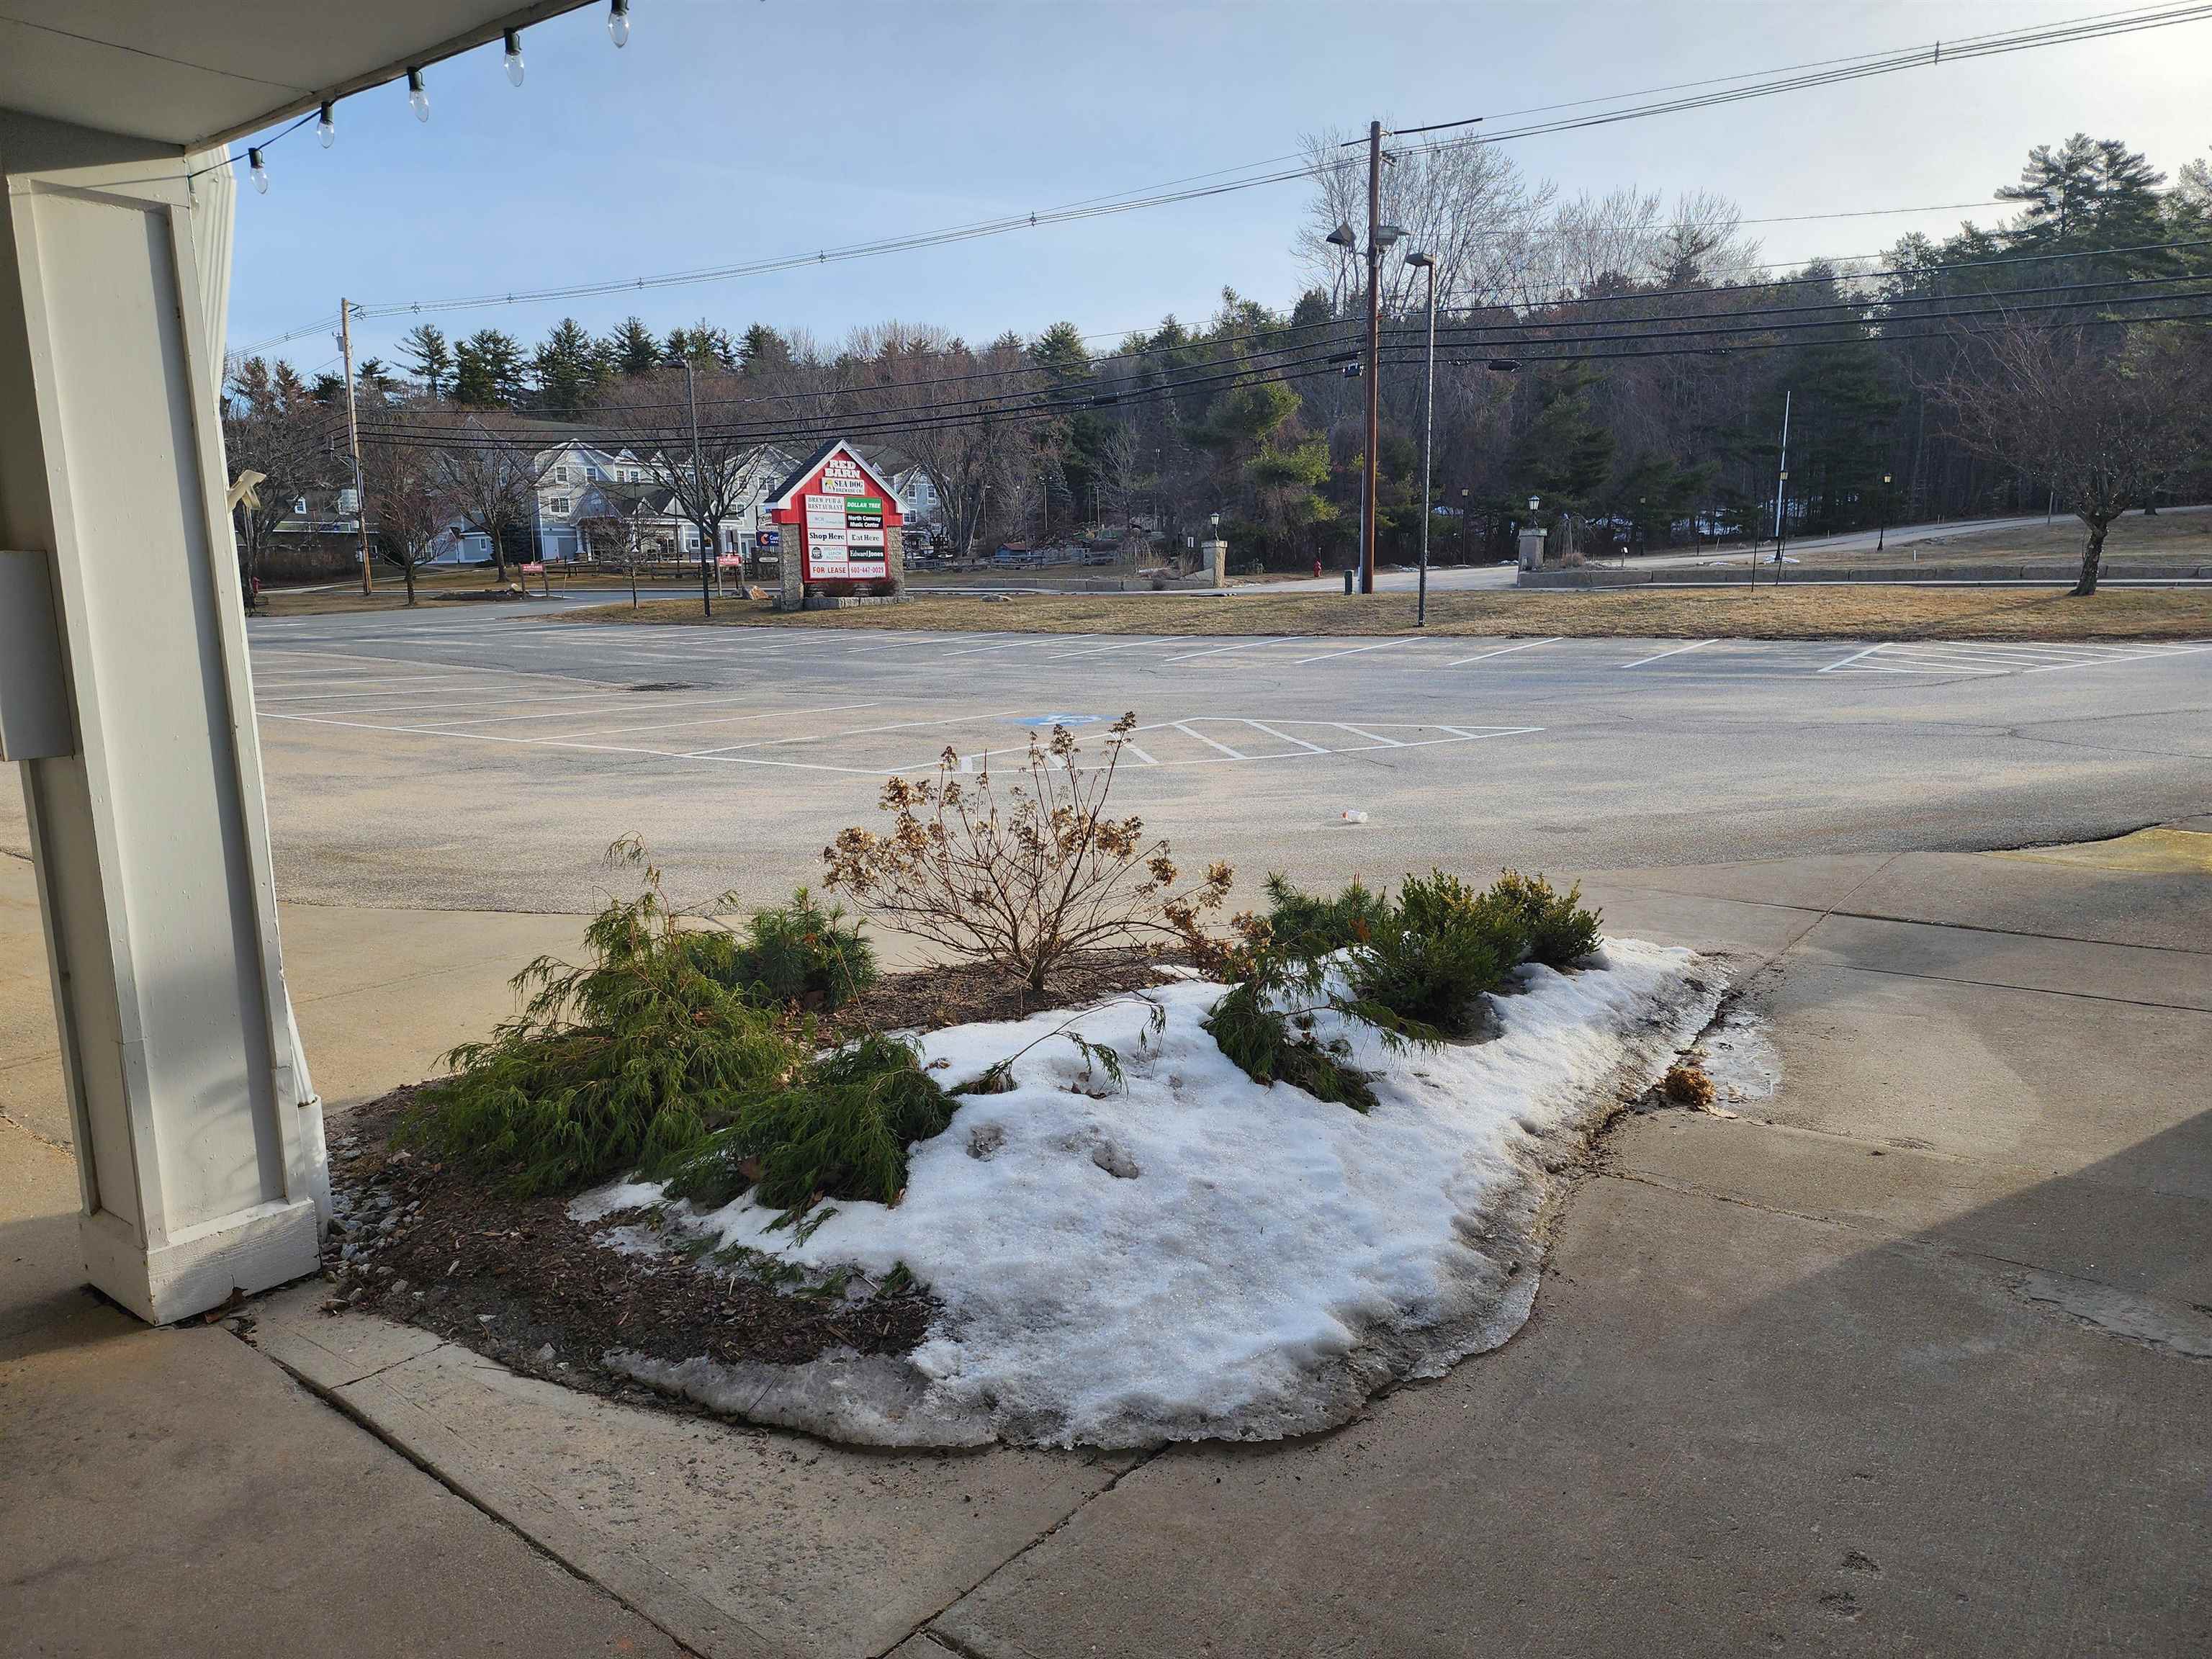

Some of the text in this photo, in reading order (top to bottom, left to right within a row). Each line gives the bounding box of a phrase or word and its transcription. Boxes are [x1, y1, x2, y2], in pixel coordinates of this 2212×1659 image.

[829, 459, 856, 469] RED
[824, 467, 860, 479] BARN
[809, 532, 827, 541] Shop
